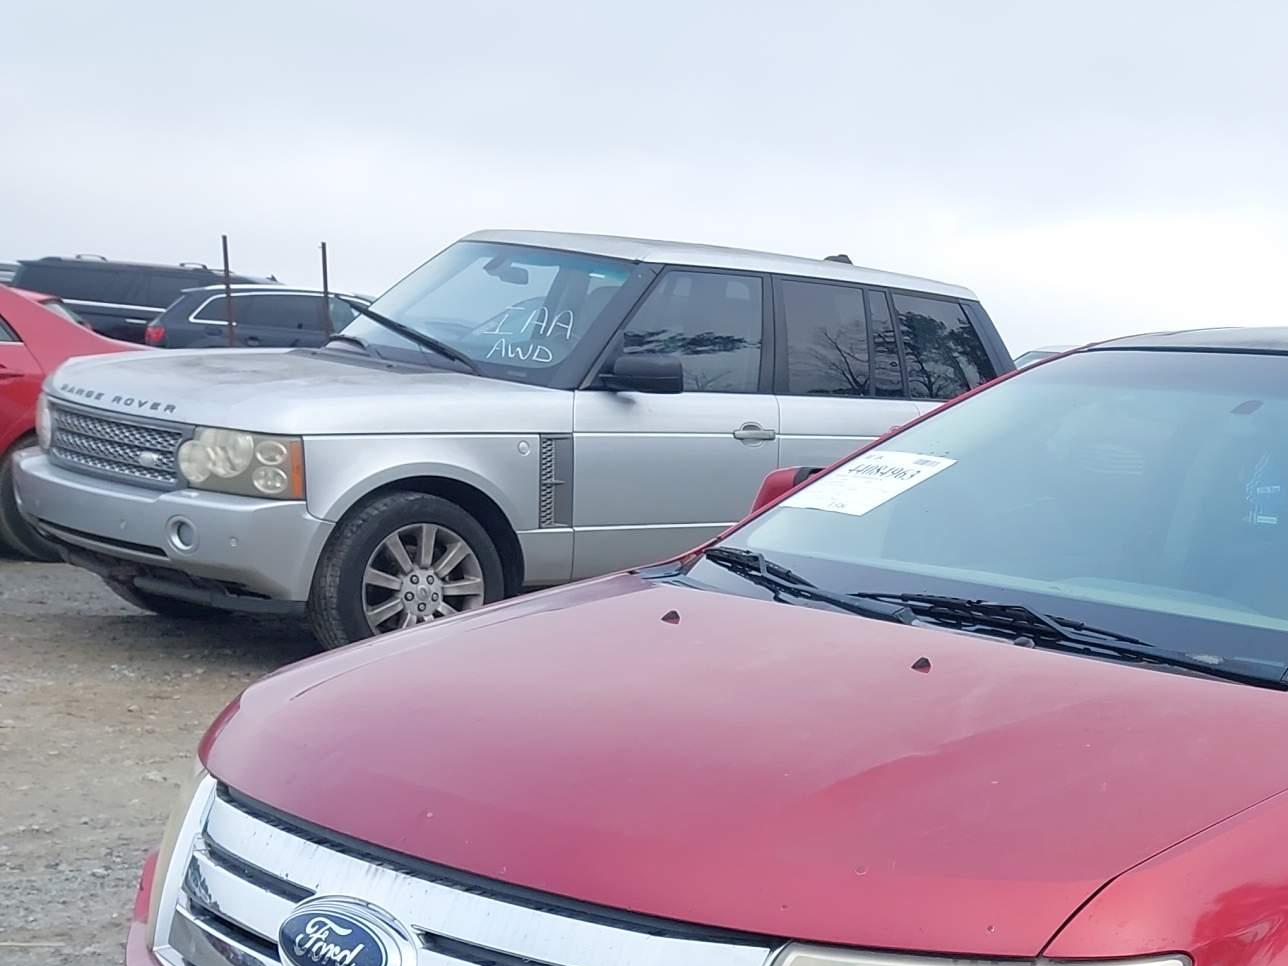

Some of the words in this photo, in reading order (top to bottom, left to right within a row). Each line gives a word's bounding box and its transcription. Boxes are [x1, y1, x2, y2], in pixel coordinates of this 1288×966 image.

[480, 306, 574, 340] IAA
[486, 338, 553, 362] AWD
[111, 395, 177, 414] ROVER
